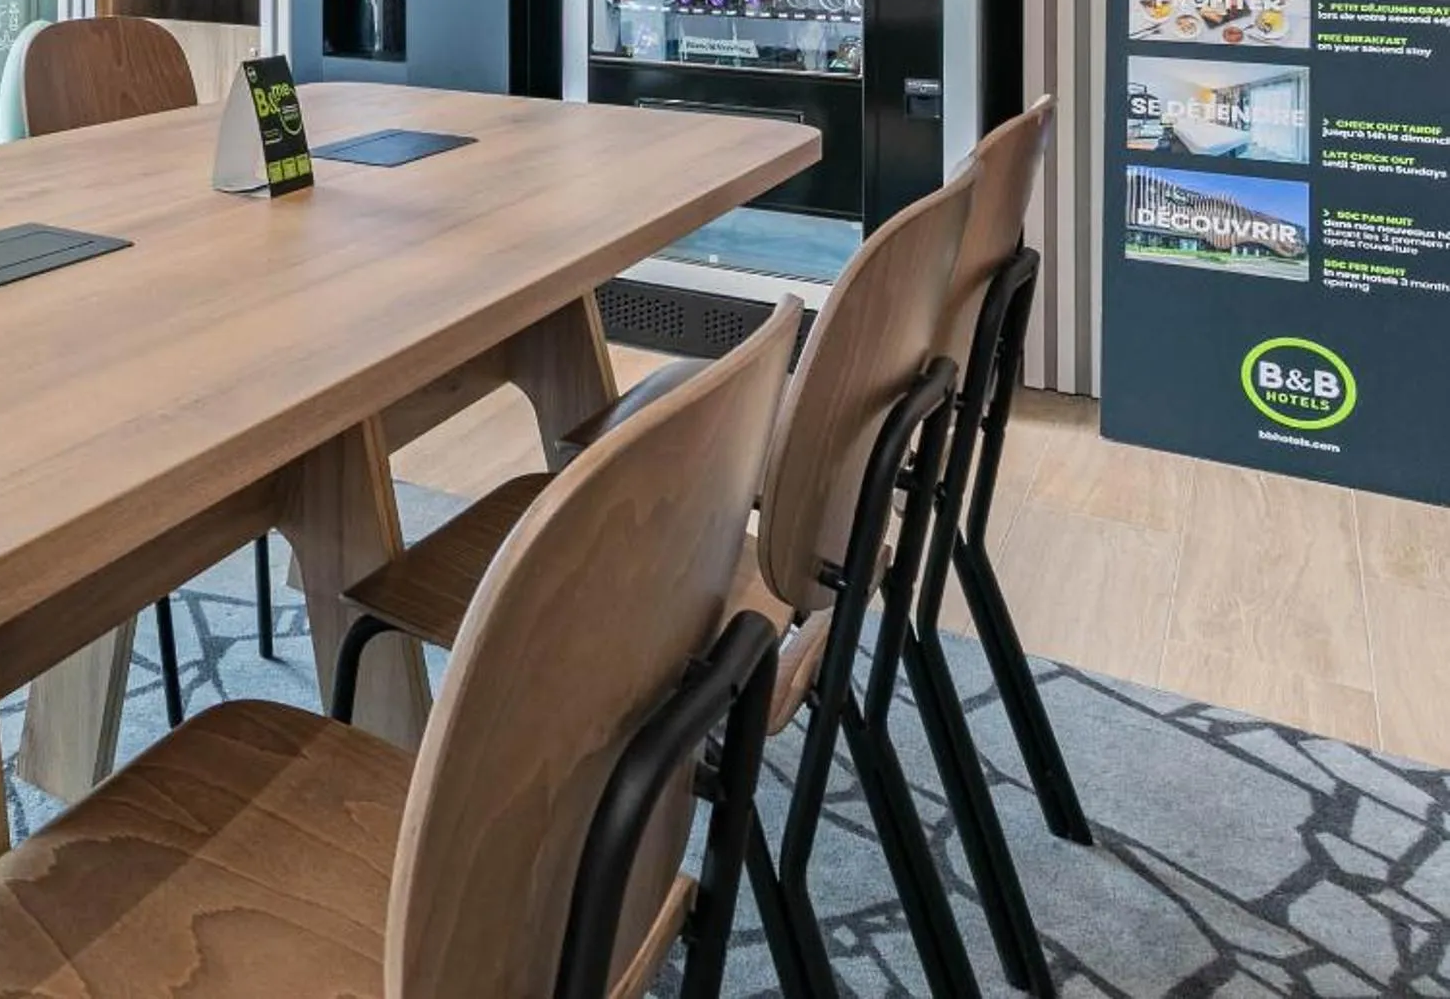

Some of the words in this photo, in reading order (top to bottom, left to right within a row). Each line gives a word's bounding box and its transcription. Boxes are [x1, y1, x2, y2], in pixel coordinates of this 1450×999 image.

[1333, 45, 1359, 53] your
[1361, 45, 1404, 55] second
[1405, 47, 1432, 58] stay
[1131, 98, 1161, 116] SE
[1336, 120, 1375, 130] CHECK
[1376, 123, 1400, 132] OUT
[1402, 124, 1443, 136] TARDIF
[1350, 152, 1389, 163] CHECK
[1391, 155, 1415, 165] OUT
[1395, 166, 1447, 180] Sundays
[1386, 216, 1414, 227] NUIT
[1391, 235, 1444, 249] premiers
[1362, 273, 1399, 285] hotels
[1258, 360, 1340, 399] B&B
[1265, 390, 1331, 411] HOTELS
[1258, 429, 1341, 453] bbhotels.com
